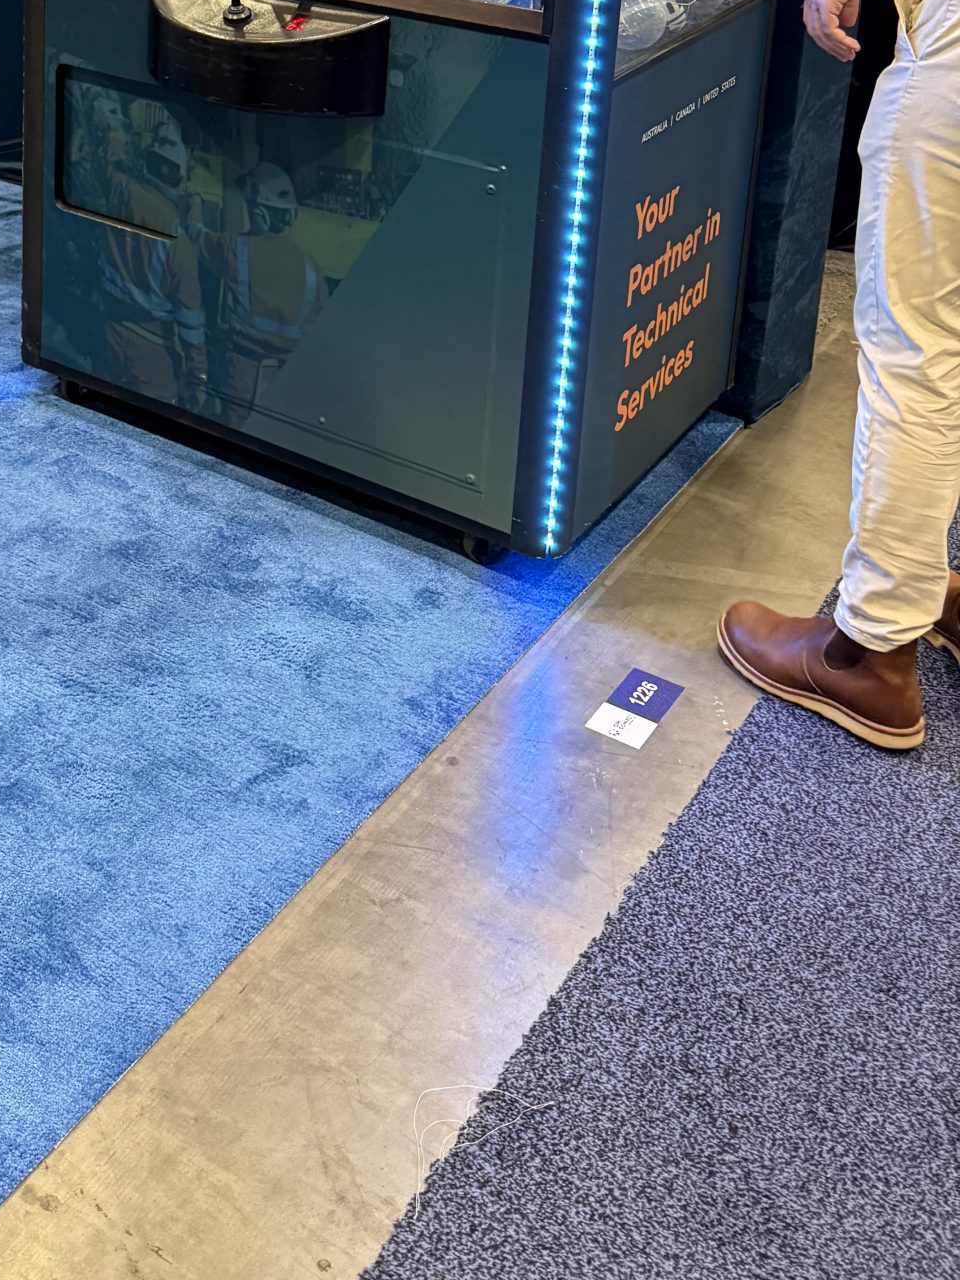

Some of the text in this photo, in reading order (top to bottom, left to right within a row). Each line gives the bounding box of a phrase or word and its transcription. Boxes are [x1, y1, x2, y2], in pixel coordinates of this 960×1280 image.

[641, 120, 668, 143] AUSTRALIA
[675, 102, 695, 121] CANADA
[702, 87, 719, 104] UNITED
[721, 76, 736, 93] STATES
[635, 185, 680, 240] Your
[626, 208, 721, 308] Partner in
[622, 262, 710, 367] Technical
[614, 340, 694, 432] Services
[628, 681, 658, 706] 1226
